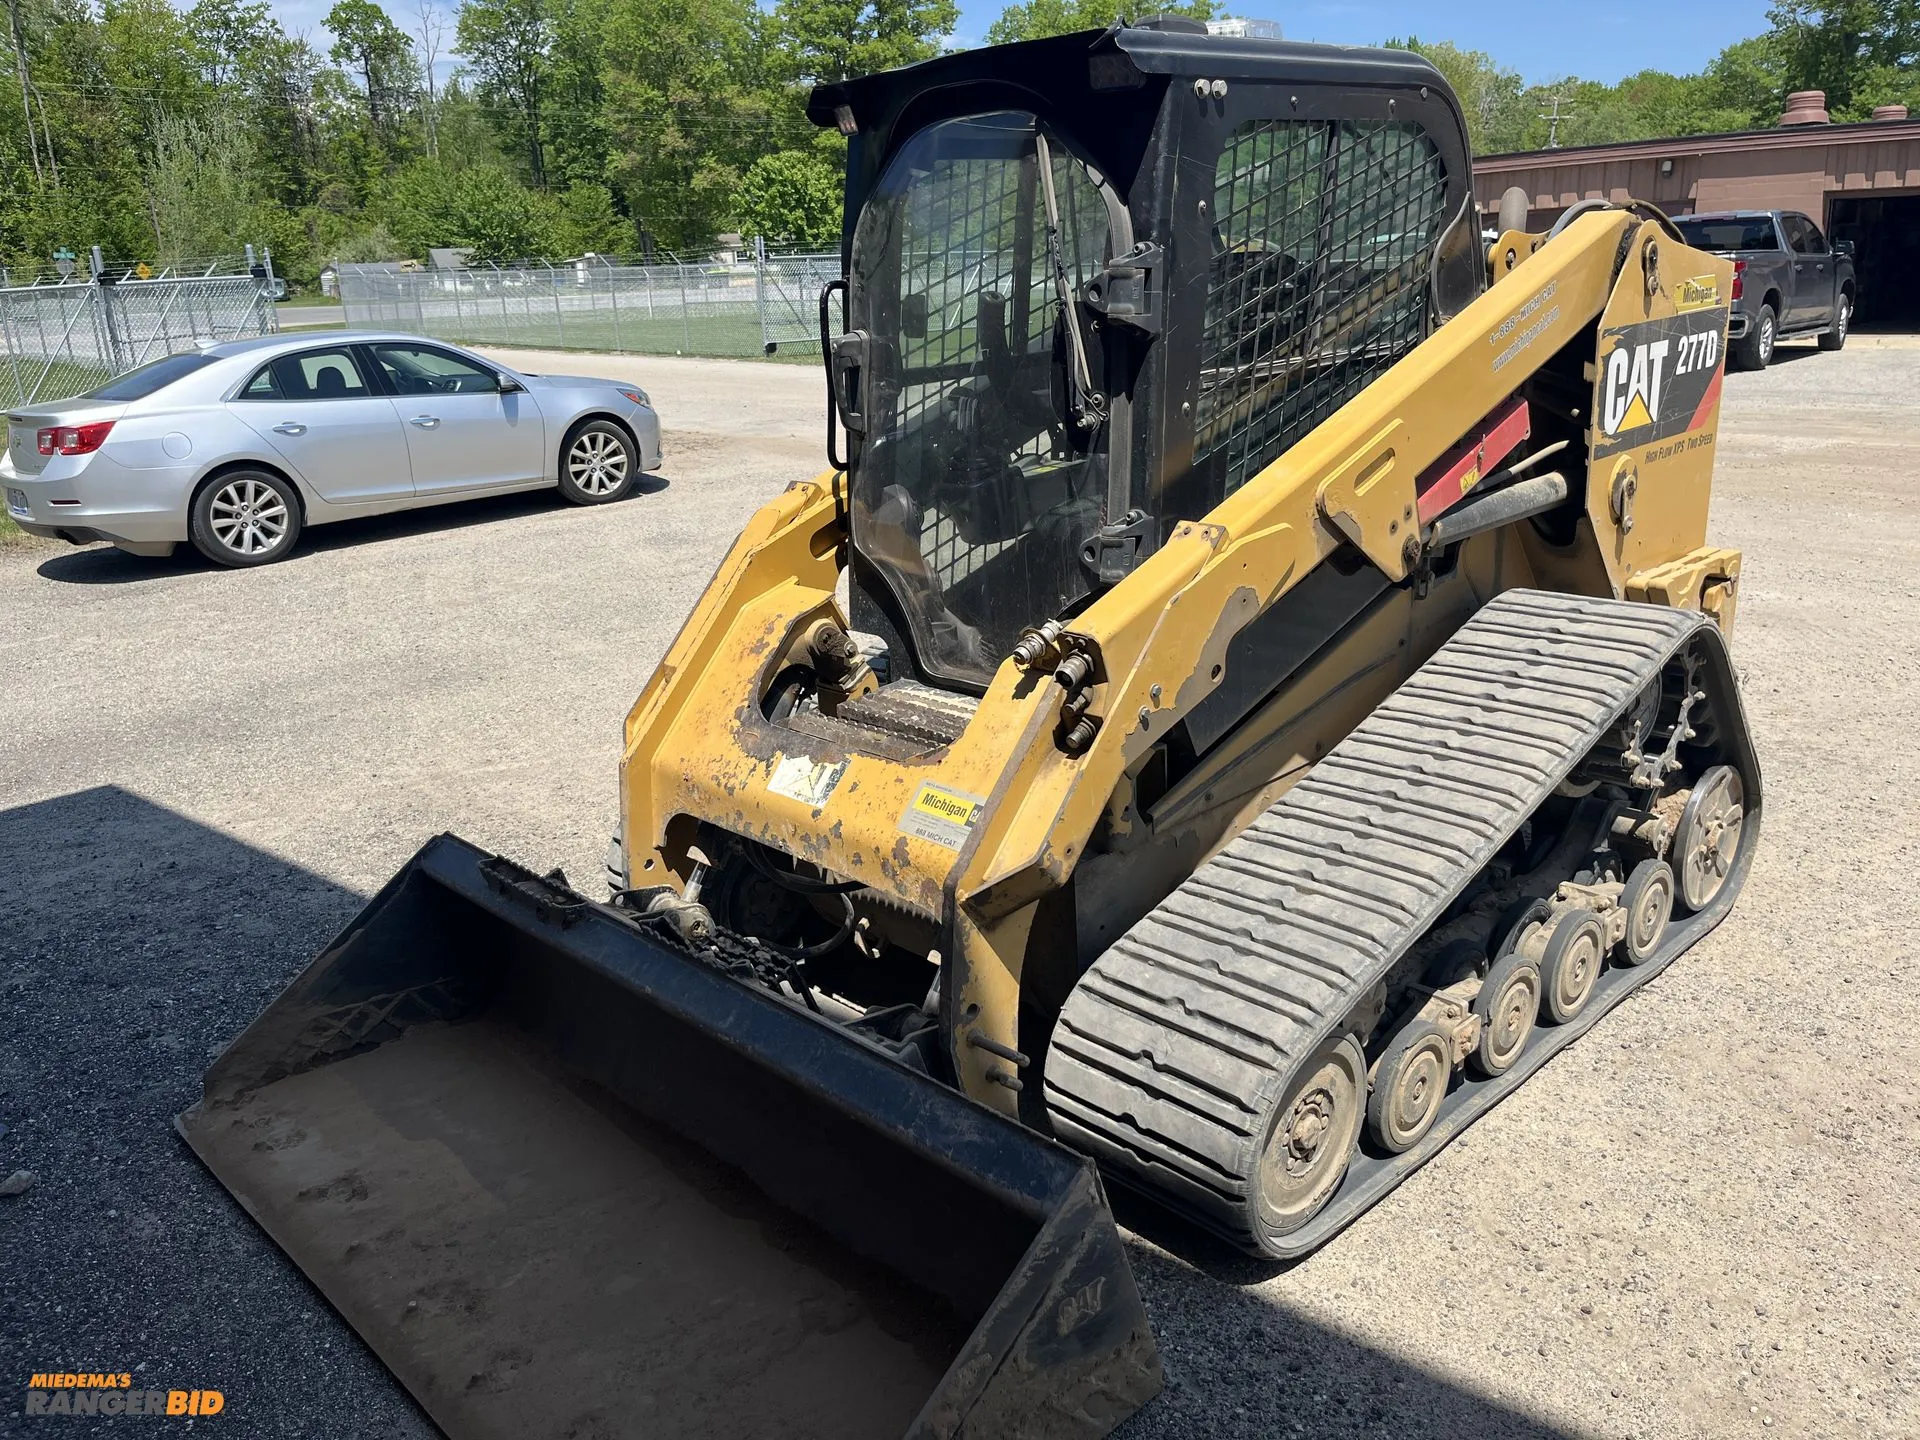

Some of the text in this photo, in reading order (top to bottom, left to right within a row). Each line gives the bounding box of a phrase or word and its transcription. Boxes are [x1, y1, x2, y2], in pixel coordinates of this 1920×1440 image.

[1541, 280, 1558, 303] CAT
[1682, 286, 1713, 304] Michigan
[1675, 329, 1718, 376] 277D
[1603, 339, 1669, 436] CAT
[921, 792, 968, 818] Michigan
[926, 831, 943, 843] MICH
[943, 837, 958, 848] CAT
